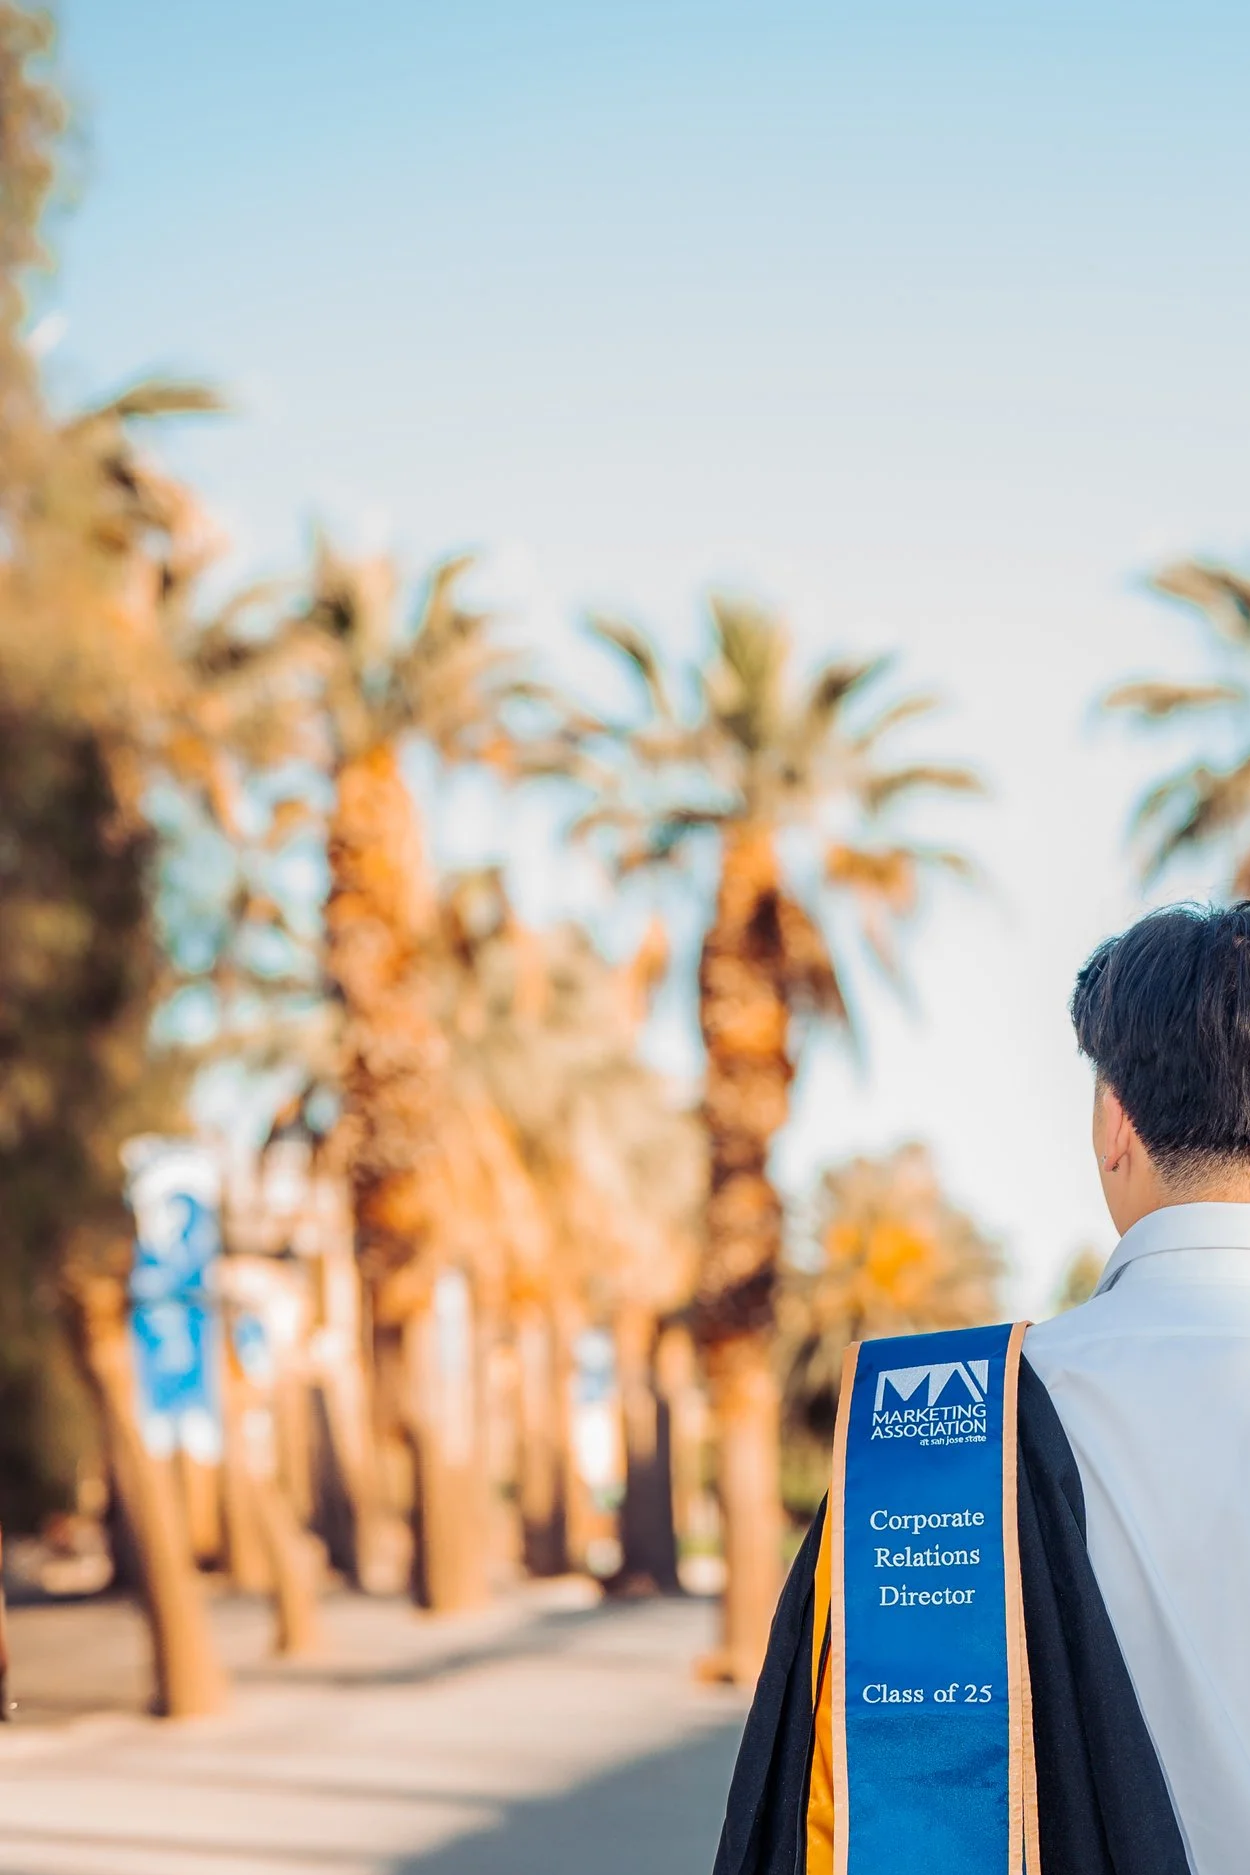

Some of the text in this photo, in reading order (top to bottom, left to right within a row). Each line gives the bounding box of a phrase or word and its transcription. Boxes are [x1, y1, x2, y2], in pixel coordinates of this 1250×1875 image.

[872, 1403, 987, 1426] MARKETING
[870, 1418, 987, 1440] ASSOCIATION
[930, 1438, 945, 1446] san
[945, 1436, 964, 1446] jose
[964, 1434, 987, 1443] state
[869, 1509, 985, 1535] Corporate
[873, 1543, 980, 1568] Relations
[879, 1584, 976, 1606] Director
[862, 1682, 993, 1704] Class of 25
